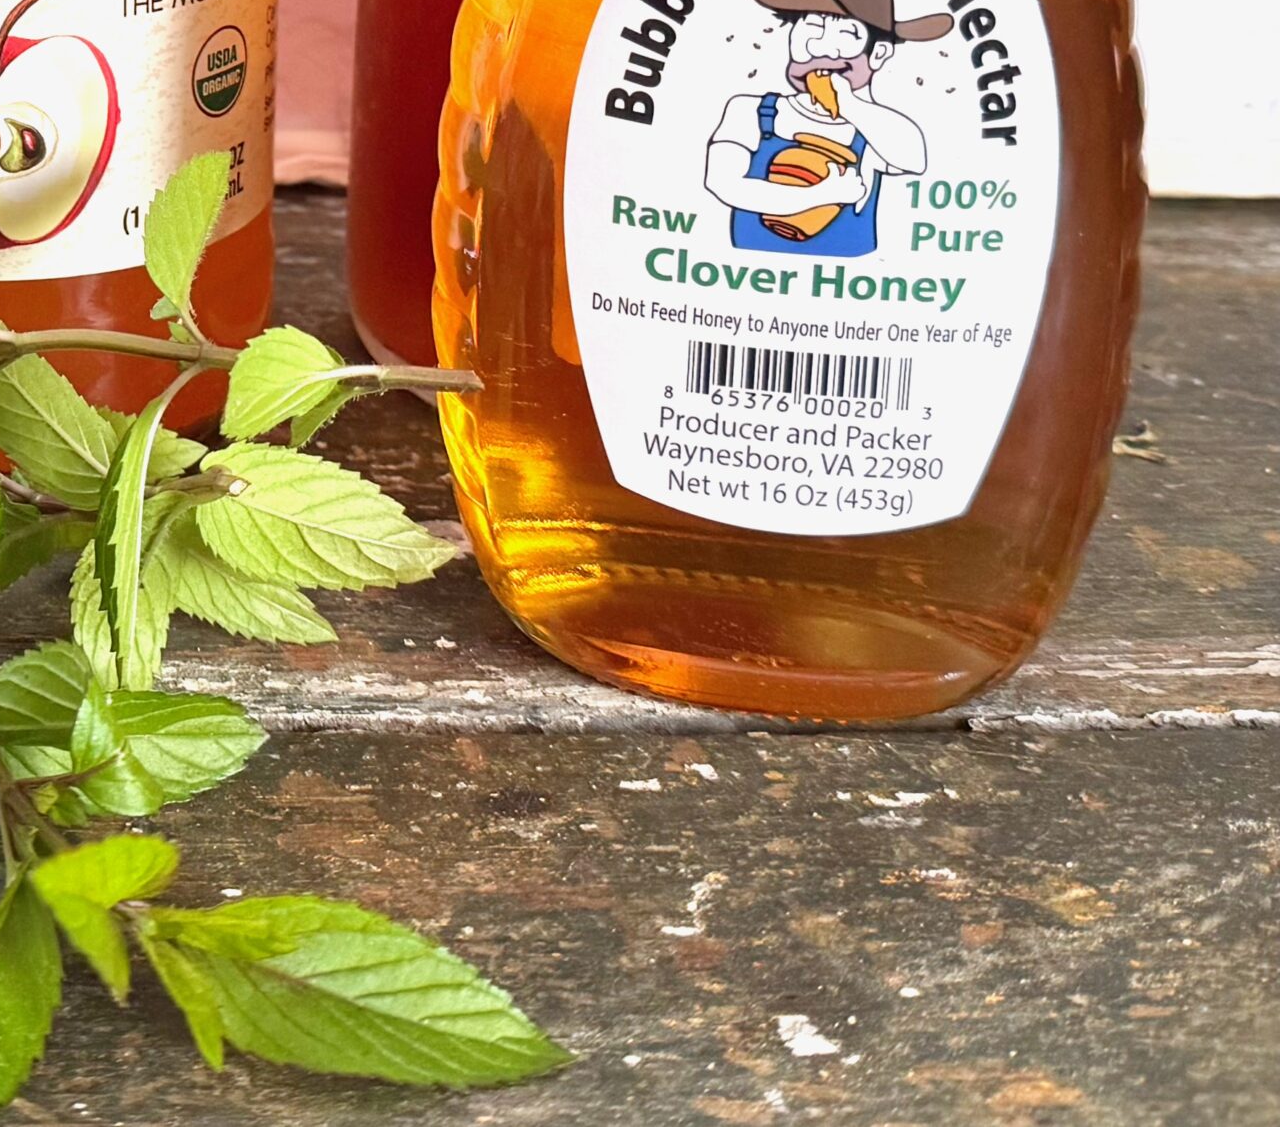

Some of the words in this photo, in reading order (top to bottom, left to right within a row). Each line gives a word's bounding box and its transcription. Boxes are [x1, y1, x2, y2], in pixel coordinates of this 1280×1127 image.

[207, 44, 238, 72] USDA
[202, 68, 243, 97] ORGANIC
[904, 179, 1018, 210] 100%
[612, 195, 698, 234] Raw
[910, 221, 1004, 253] Pure
[644, 247, 798, 296] Clover
[810, 264, 967, 312] Honey
[591, 292, 613, 313] Do
[617, 295, 646, 319] Not
[650, 301, 687, 325] Feed
[692, 307, 743, 336] Honey
[747, 314, 765, 334] to
[768, 316, 829, 344] Anyone
[833, 320, 883, 343] Under
[887, 323, 920, 344] One
[924, 324, 959, 345] Year
[962, 324, 981, 344] of
[982, 324, 1013, 349] Age
[663, 385, 675, 400] 8
[710, 387, 790, 414] 65376
[803, 397, 886, 420] 00020
[922, 406, 933, 421] 3
[658, 405, 780, 444] Producer
[786, 424, 837, 448] and
[845, 425, 933, 452] Packer
[642, 431, 814, 478] Waynesboro,
[821, 453, 855, 478] VA
[863, 456, 944, 481] 22980
[667, 469, 711, 498] Net
[718, 478, 751, 502] wt
[759, 480, 788, 505] 16
[795, 484, 829, 509] Oz
[835, 485, 914, 517] (453g)
